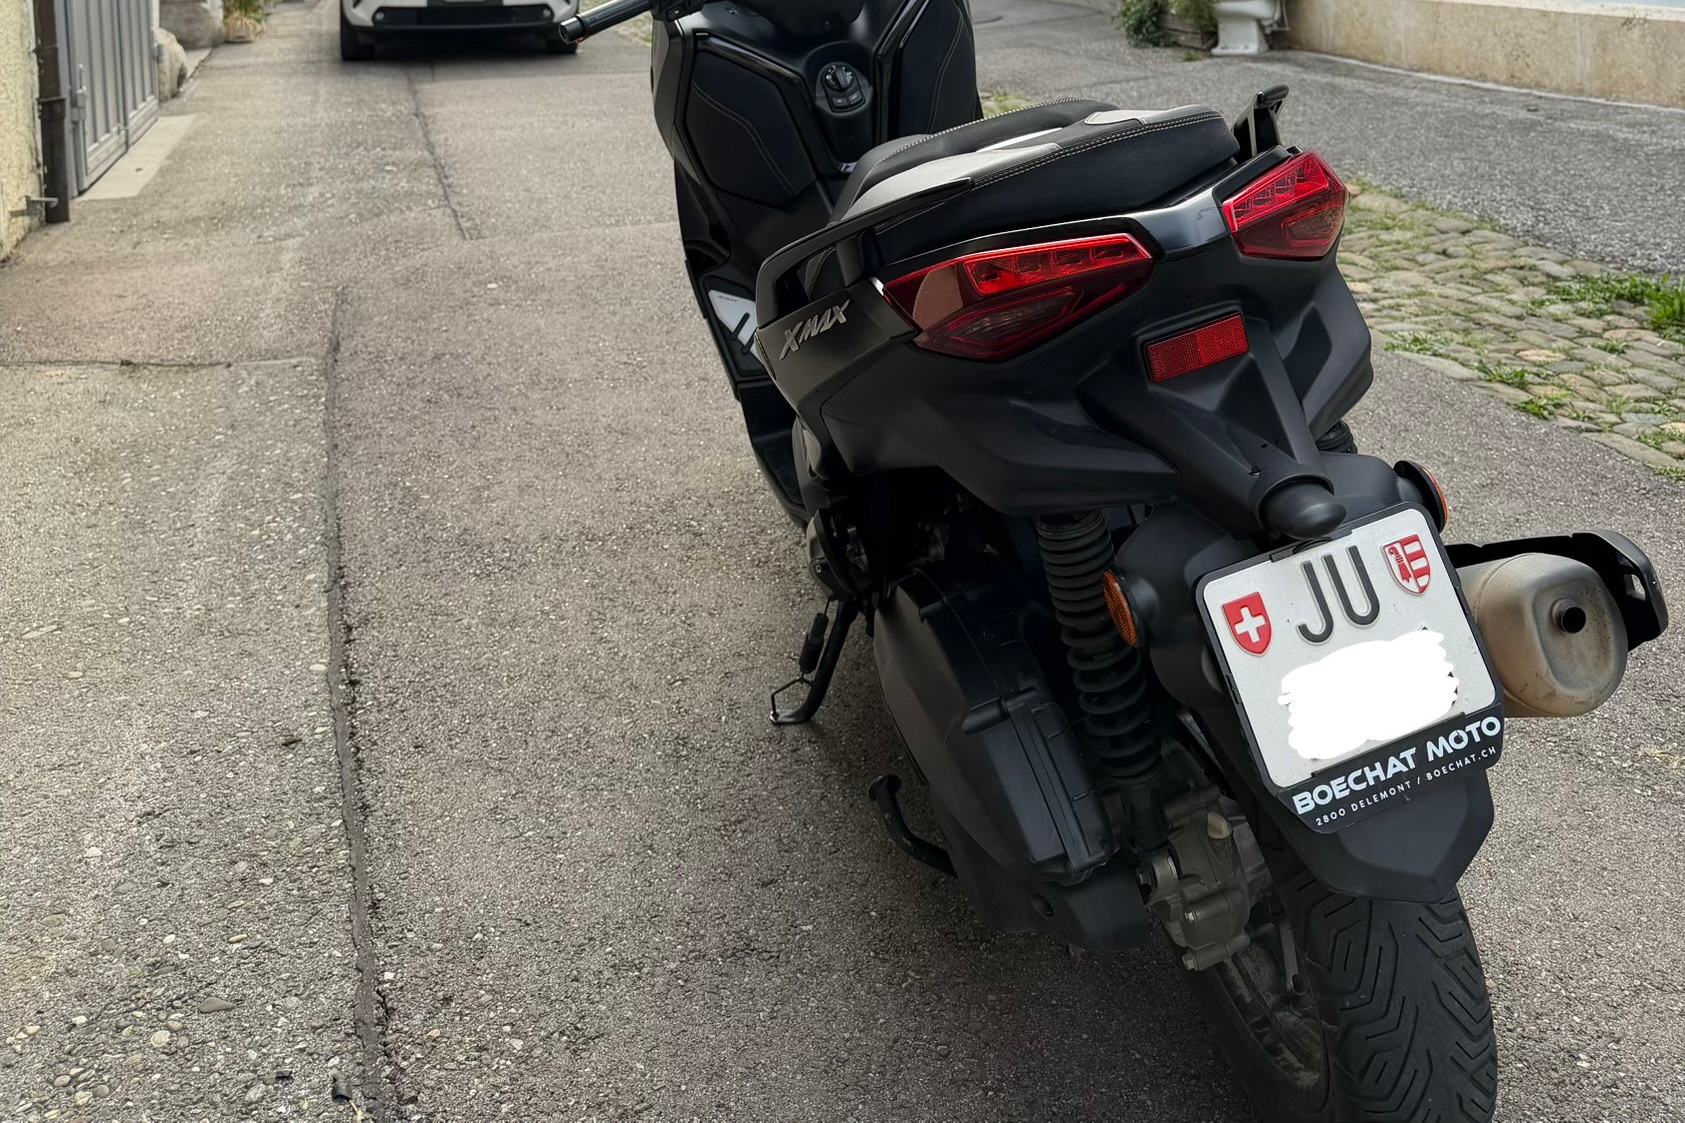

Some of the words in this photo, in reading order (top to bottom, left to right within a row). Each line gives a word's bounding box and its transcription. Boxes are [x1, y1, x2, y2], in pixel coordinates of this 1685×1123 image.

[779, 299, 850, 361] XMAX
[1297, 545, 1381, 644] JU
[1292, 747, 1417, 815] BOECHAT
[1426, 716, 1501, 762] MOTO
[1315, 808, 1346, 826] 2800
[1351, 780, 1412, 812] DELEMONT
[1426, 746, 1497, 781] BOECHAT.CH
